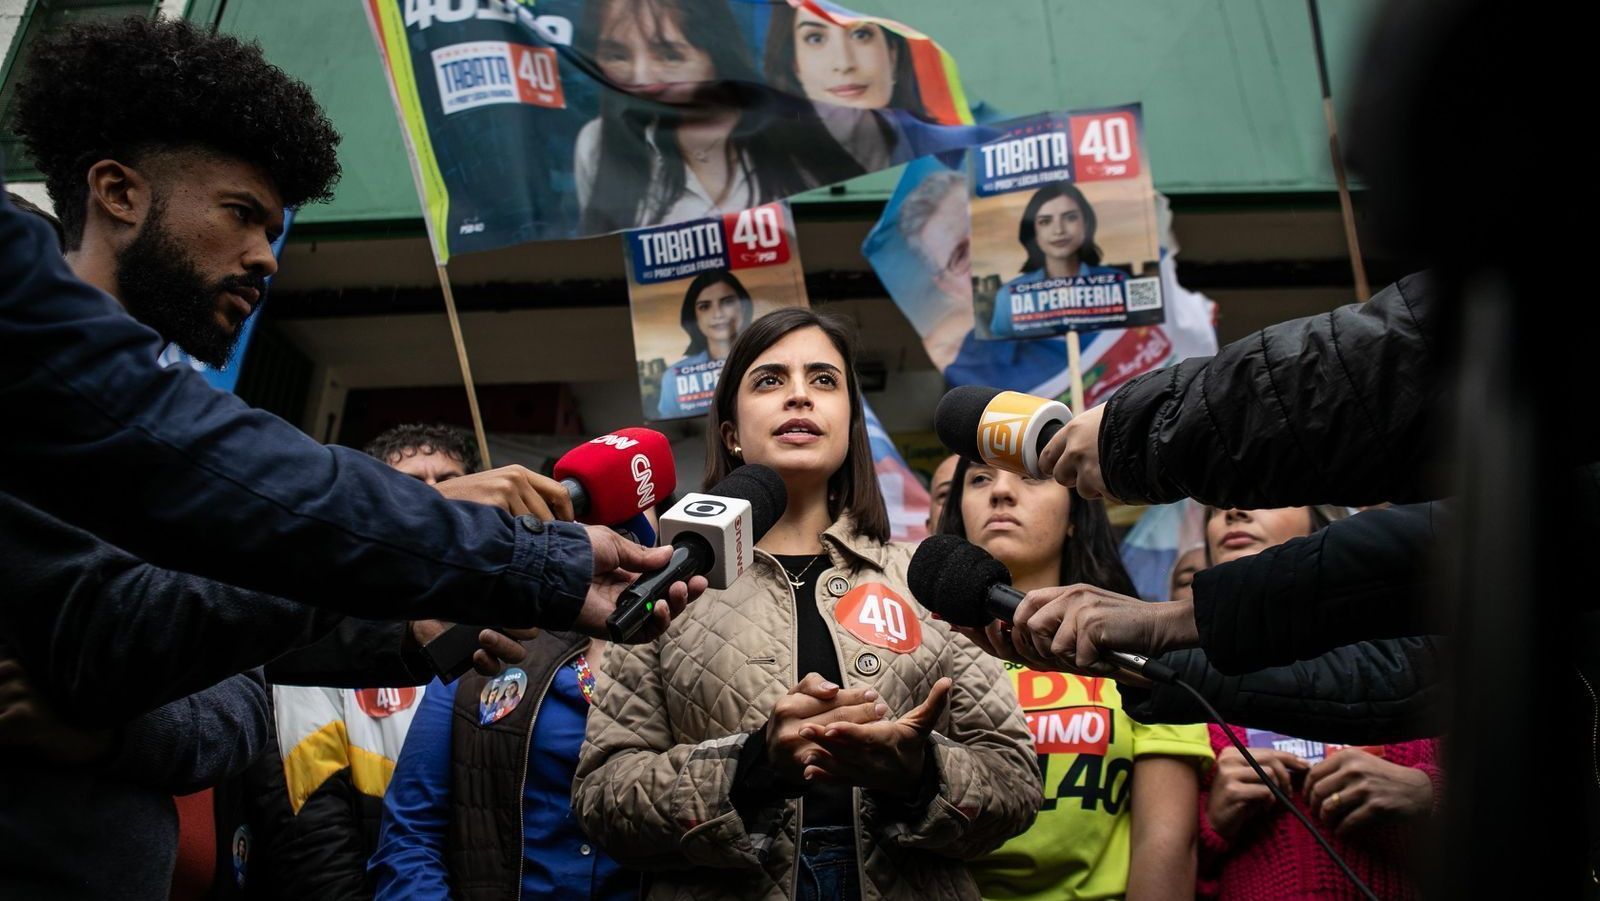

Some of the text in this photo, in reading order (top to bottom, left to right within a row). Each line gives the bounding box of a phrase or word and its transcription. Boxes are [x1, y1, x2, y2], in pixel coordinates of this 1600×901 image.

[441, 56, 511, 93] TABATA
[519, 49, 556, 91] 40
[981, 132, 1068, 178] TABATA
[1079, 116, 1132, 163] 40
[638, 222, 723, 267] TABATA
[733, 207, 782, 250] 40
[1011, 293, 1035, 315] DA
[1037, 284, 1124, 309] PERIFERIA
[1016, 274, 1116, 293] CHEGOU A VEZ
[676, 374, 700, 395] DA
[681, 360, 727, 375] CHEGO
[630, 453, 655, 508] CNN
[859, 594, 907, 641] 40
[377, 687, 401, 709] 40
